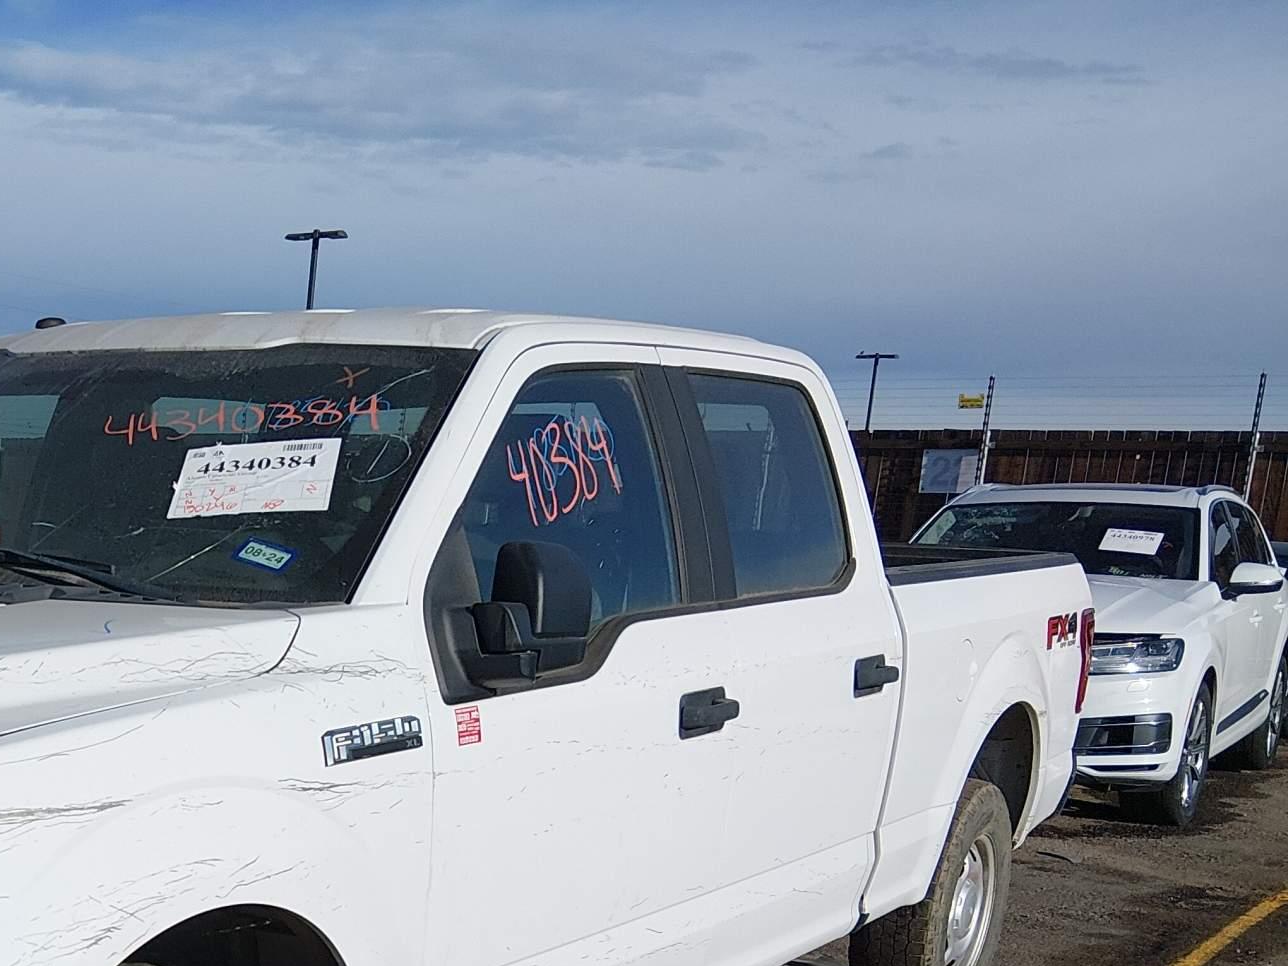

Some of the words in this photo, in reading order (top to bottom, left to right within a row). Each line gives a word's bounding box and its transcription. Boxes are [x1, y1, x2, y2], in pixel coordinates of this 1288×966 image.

[104, 393, 381, 447] 44340384
[197, 454, 317, 475] 44340384
[506, 414, 622, 528] 40384
[1046, 611, 1078, 651] FX4
